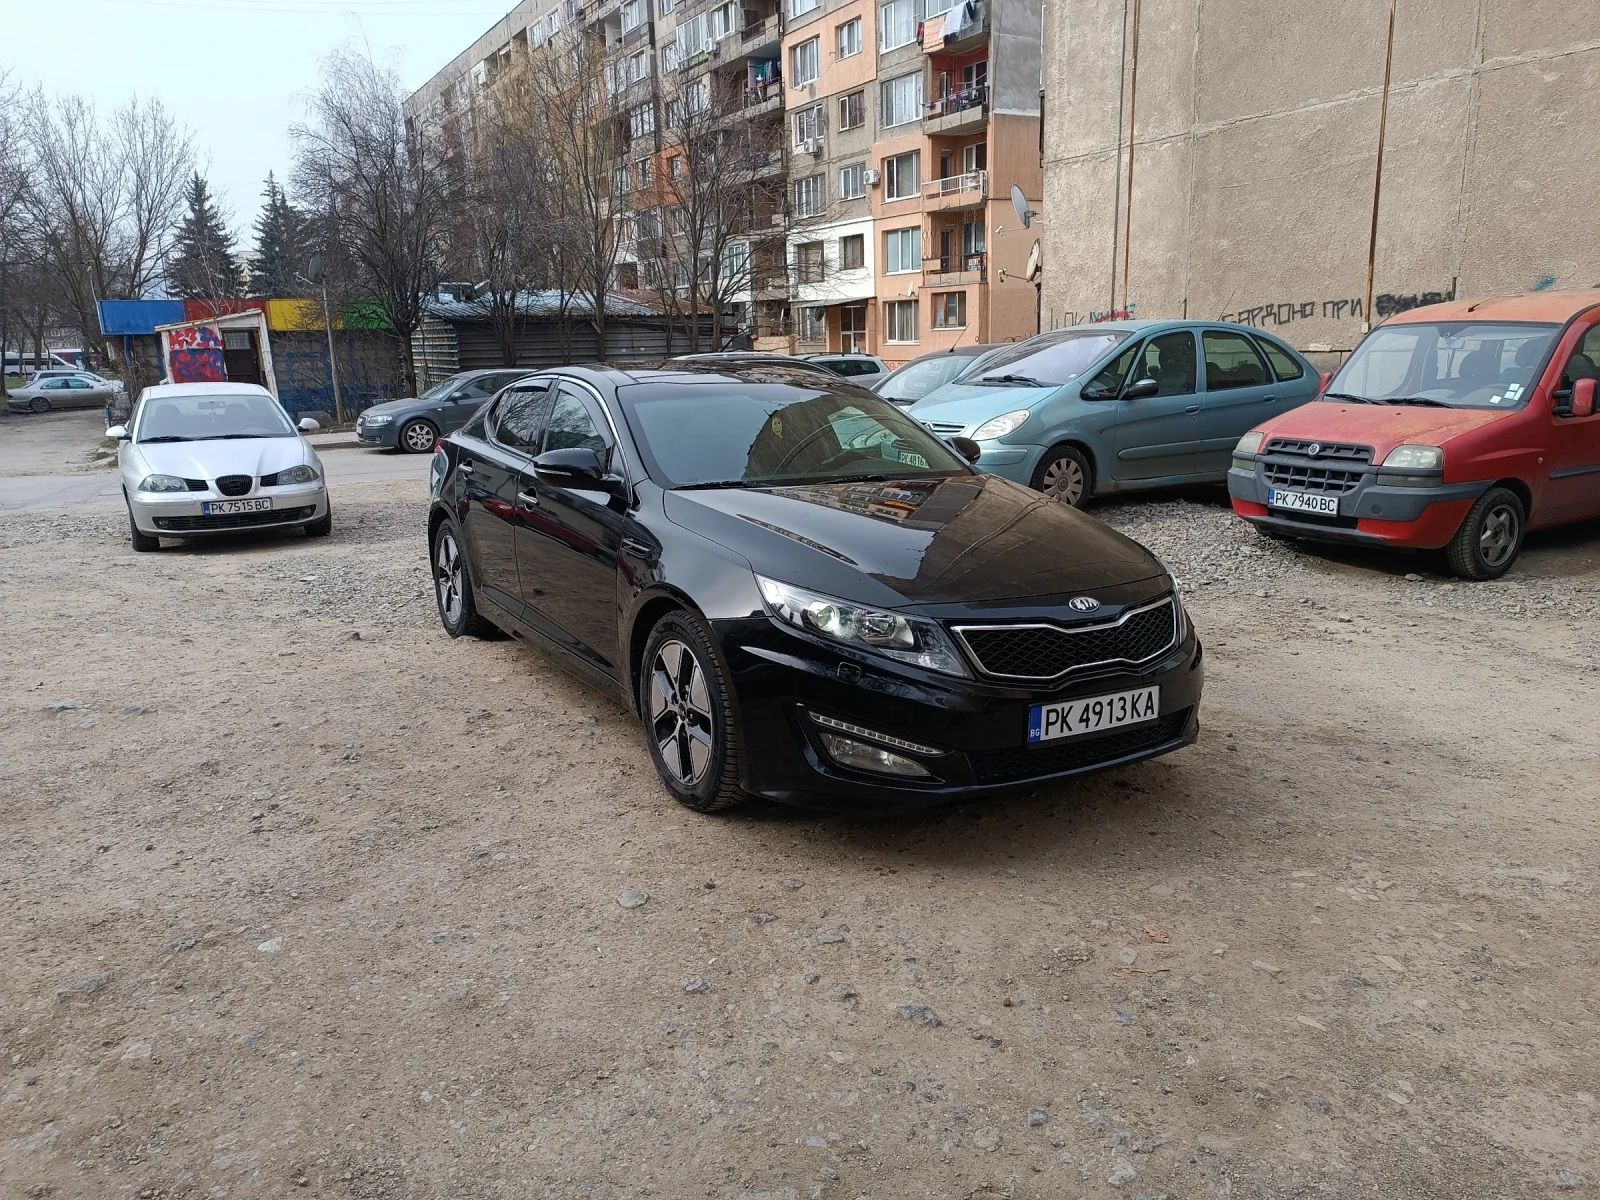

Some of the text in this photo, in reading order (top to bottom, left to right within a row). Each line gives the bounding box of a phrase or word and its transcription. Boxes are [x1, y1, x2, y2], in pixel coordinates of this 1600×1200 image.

[1323, 298, 1363, 320] ПРИ
[211, 499, 269, 513] PK 7515 BC
[1275, 492, 1335, 512] PK 7940 BC
[1072, 597, 1099, 610] KIA
[1044, 691, 1155, 736] PK 4913 KA
[1030, 728, 1040, 737] BG
